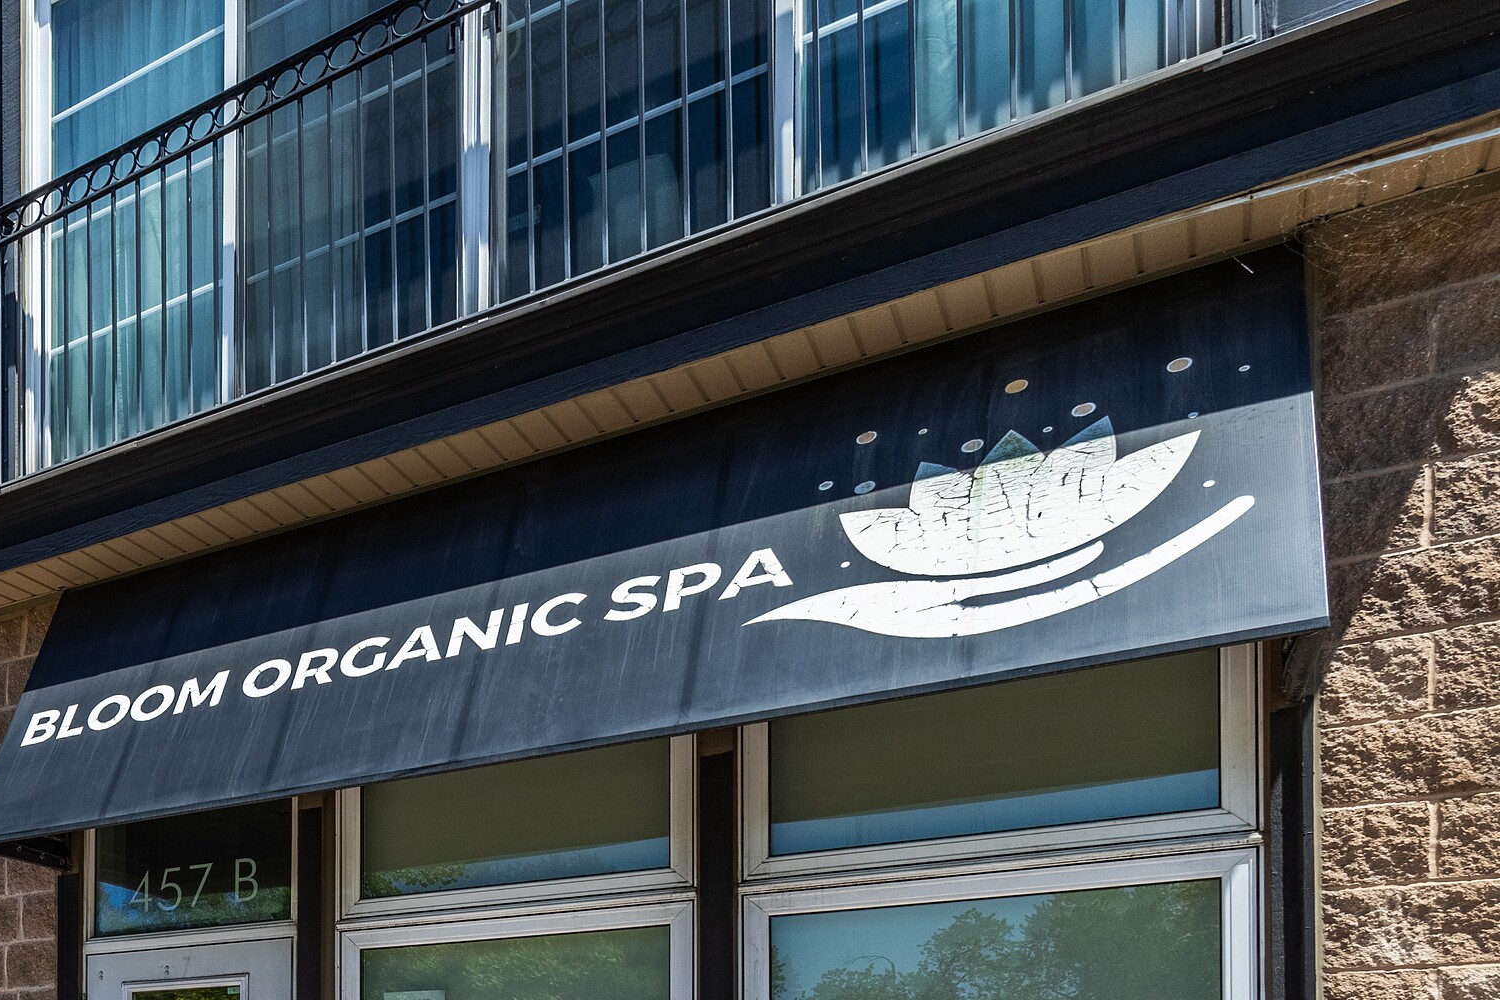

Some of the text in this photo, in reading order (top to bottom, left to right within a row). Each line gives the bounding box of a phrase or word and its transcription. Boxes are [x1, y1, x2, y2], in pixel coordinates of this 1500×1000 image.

[20, 547, 794, 748] BLOOM ORGANIC SPA
[130, 858, 259, 913] 457 B
